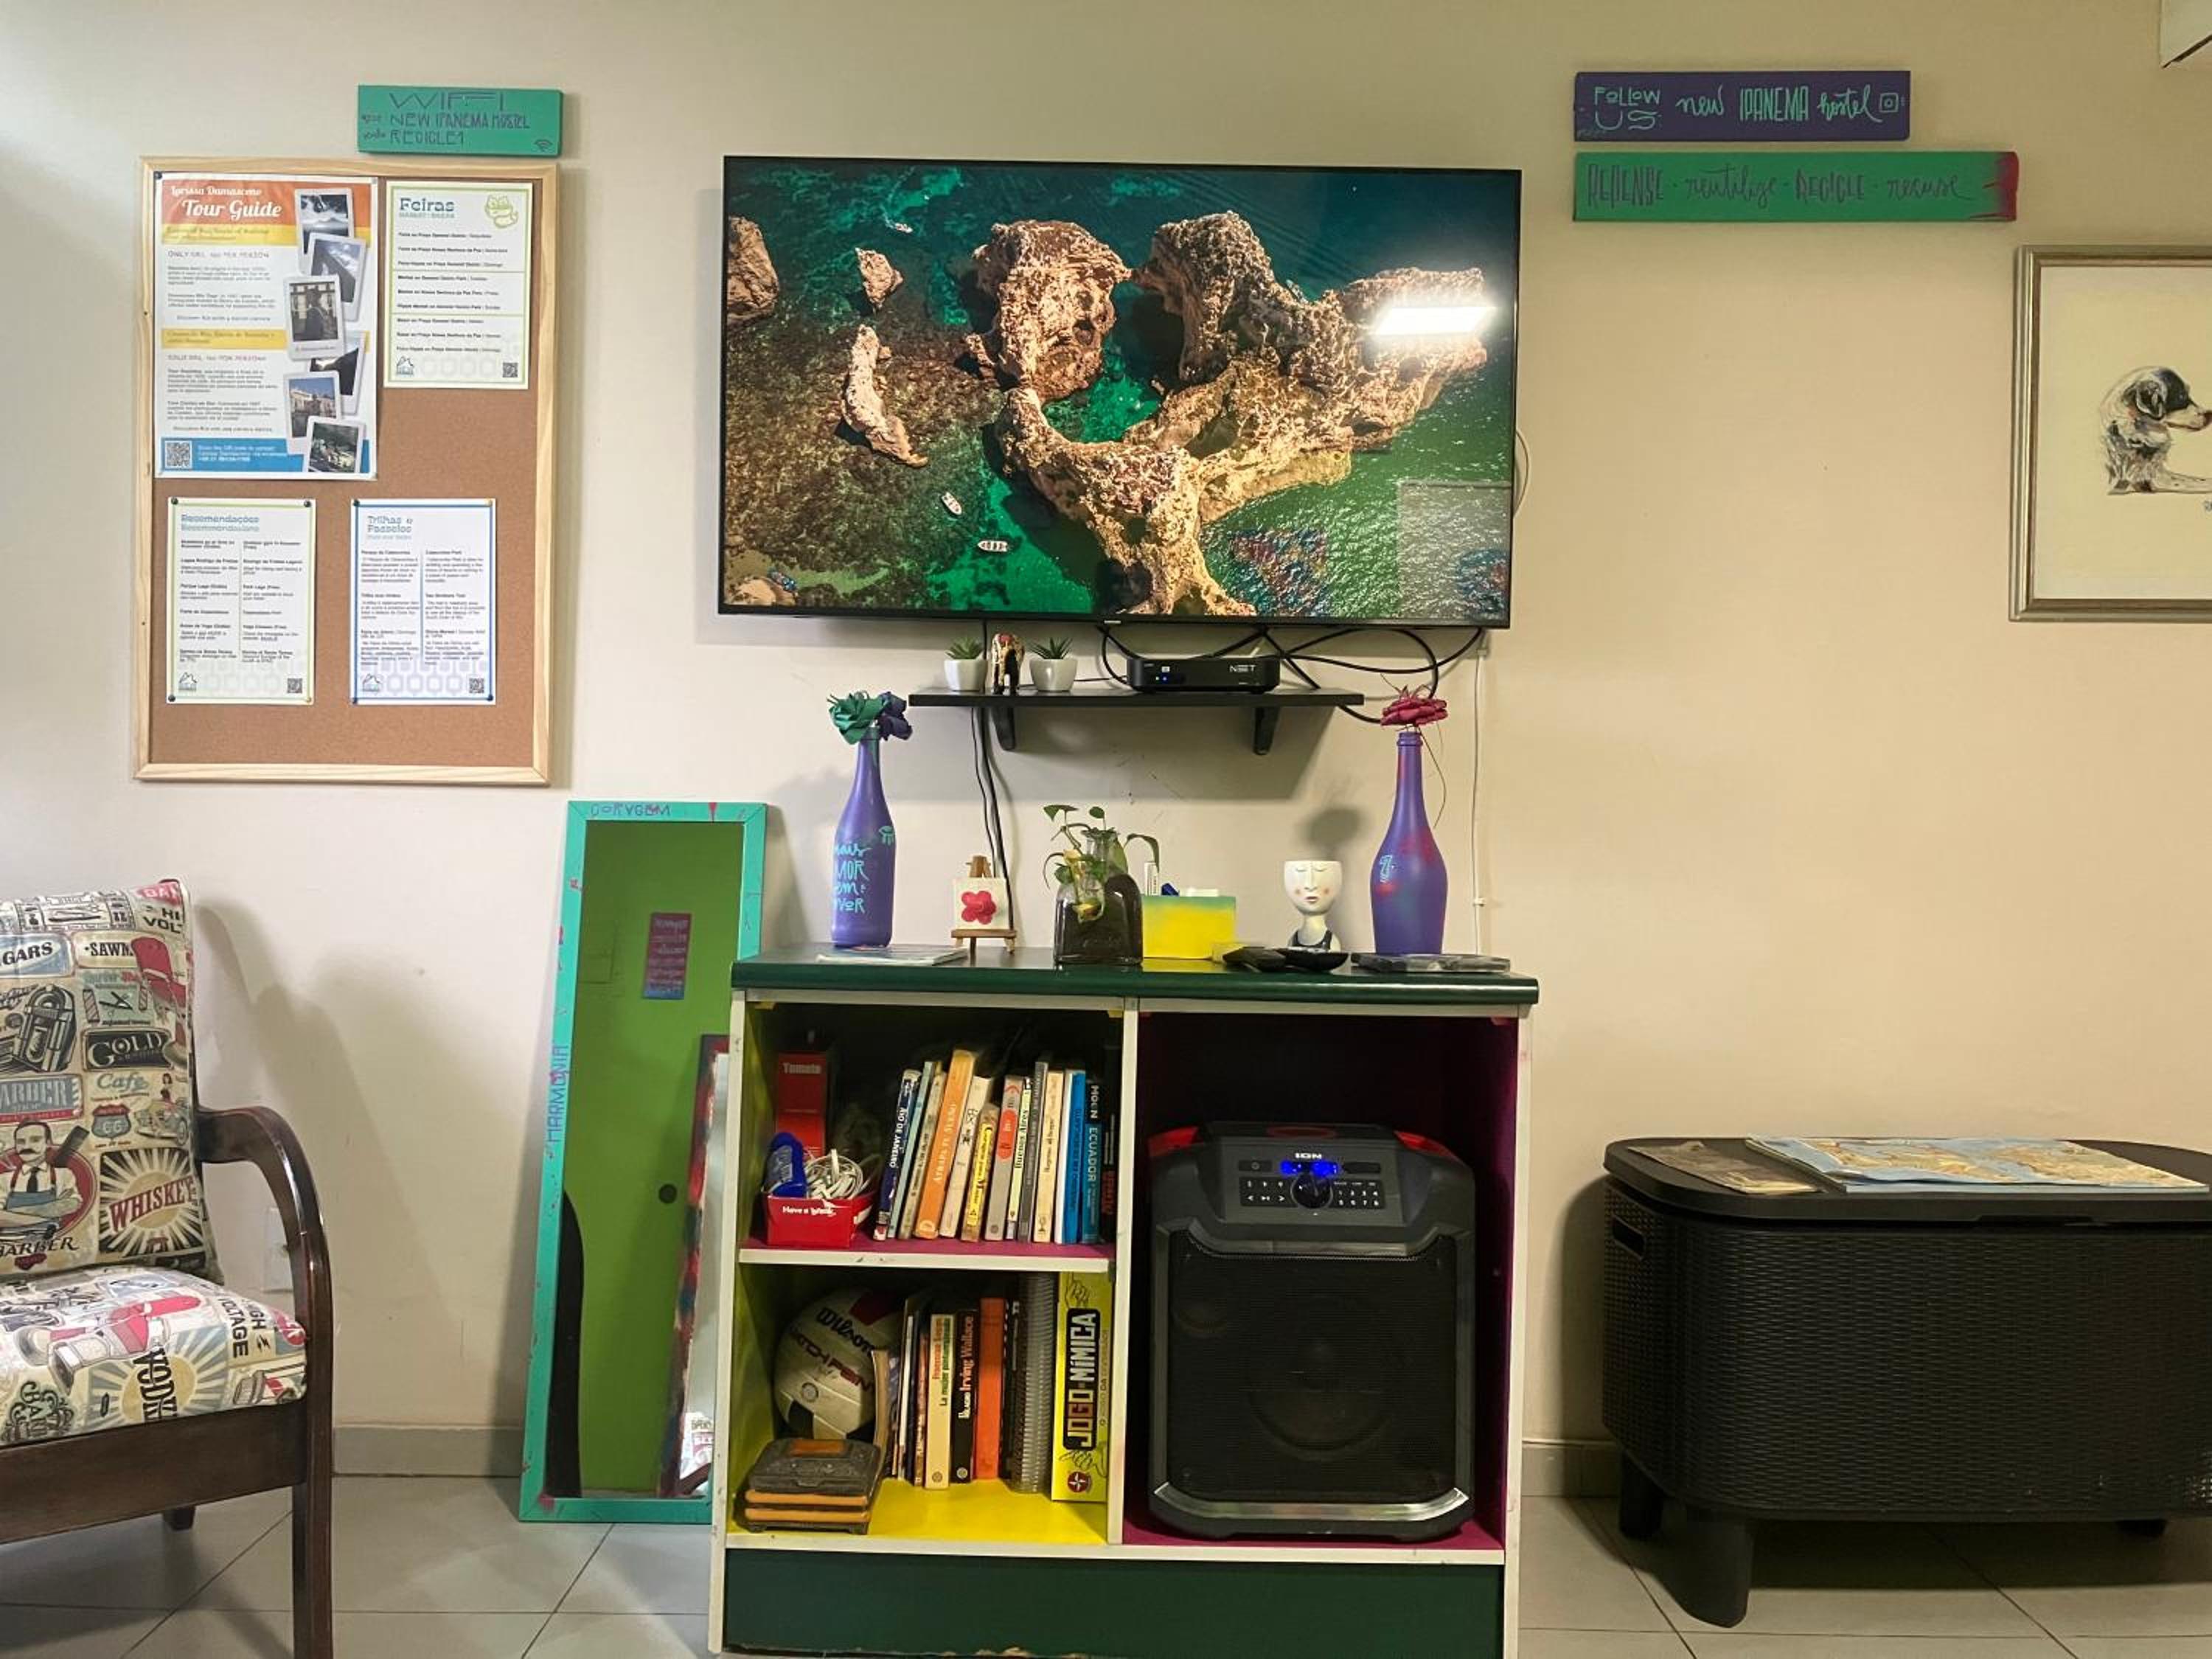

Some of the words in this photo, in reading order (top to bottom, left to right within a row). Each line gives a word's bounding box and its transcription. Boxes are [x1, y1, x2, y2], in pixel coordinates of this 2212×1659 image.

[390, 112, 431, 129] NEW
[1593, 109, 1662, 131] US
[1674, 84, 1725, 116] new
[1739, 85, 1809, 122] IPANEMA
[1816, 83, 1884, 123] hostel
[1587, 162, 1664, 209] REPENSE
[1795, 168, 1865, 204] RECICLE
[181, 199, 226, 217] Tour
[229, 200, 283, 221] Guide
[399, 197, 455, 212] Feiras
[1229, 664, 1256, 672] NET
[0, 941, 54, 967] GARS
[88, 1032, 164, 1068] GOLD
[102, 1120, 125, 1134] 66
[1014, 1138, 1026, 1169] Buenos
[1020, 1108, 1029, 1137] Aires
[1087, 1127, 1099, 1183] ECUADOR
[110, 1175, 199, 1233] WHISKEY
[218, 1298, 249, 1358] OLTAGE
[960, 1314, 974, 1357] Wallace
[959, 1358, 975, 1391] Irving
[1067, 1388, 1094, 1447] JOGO
